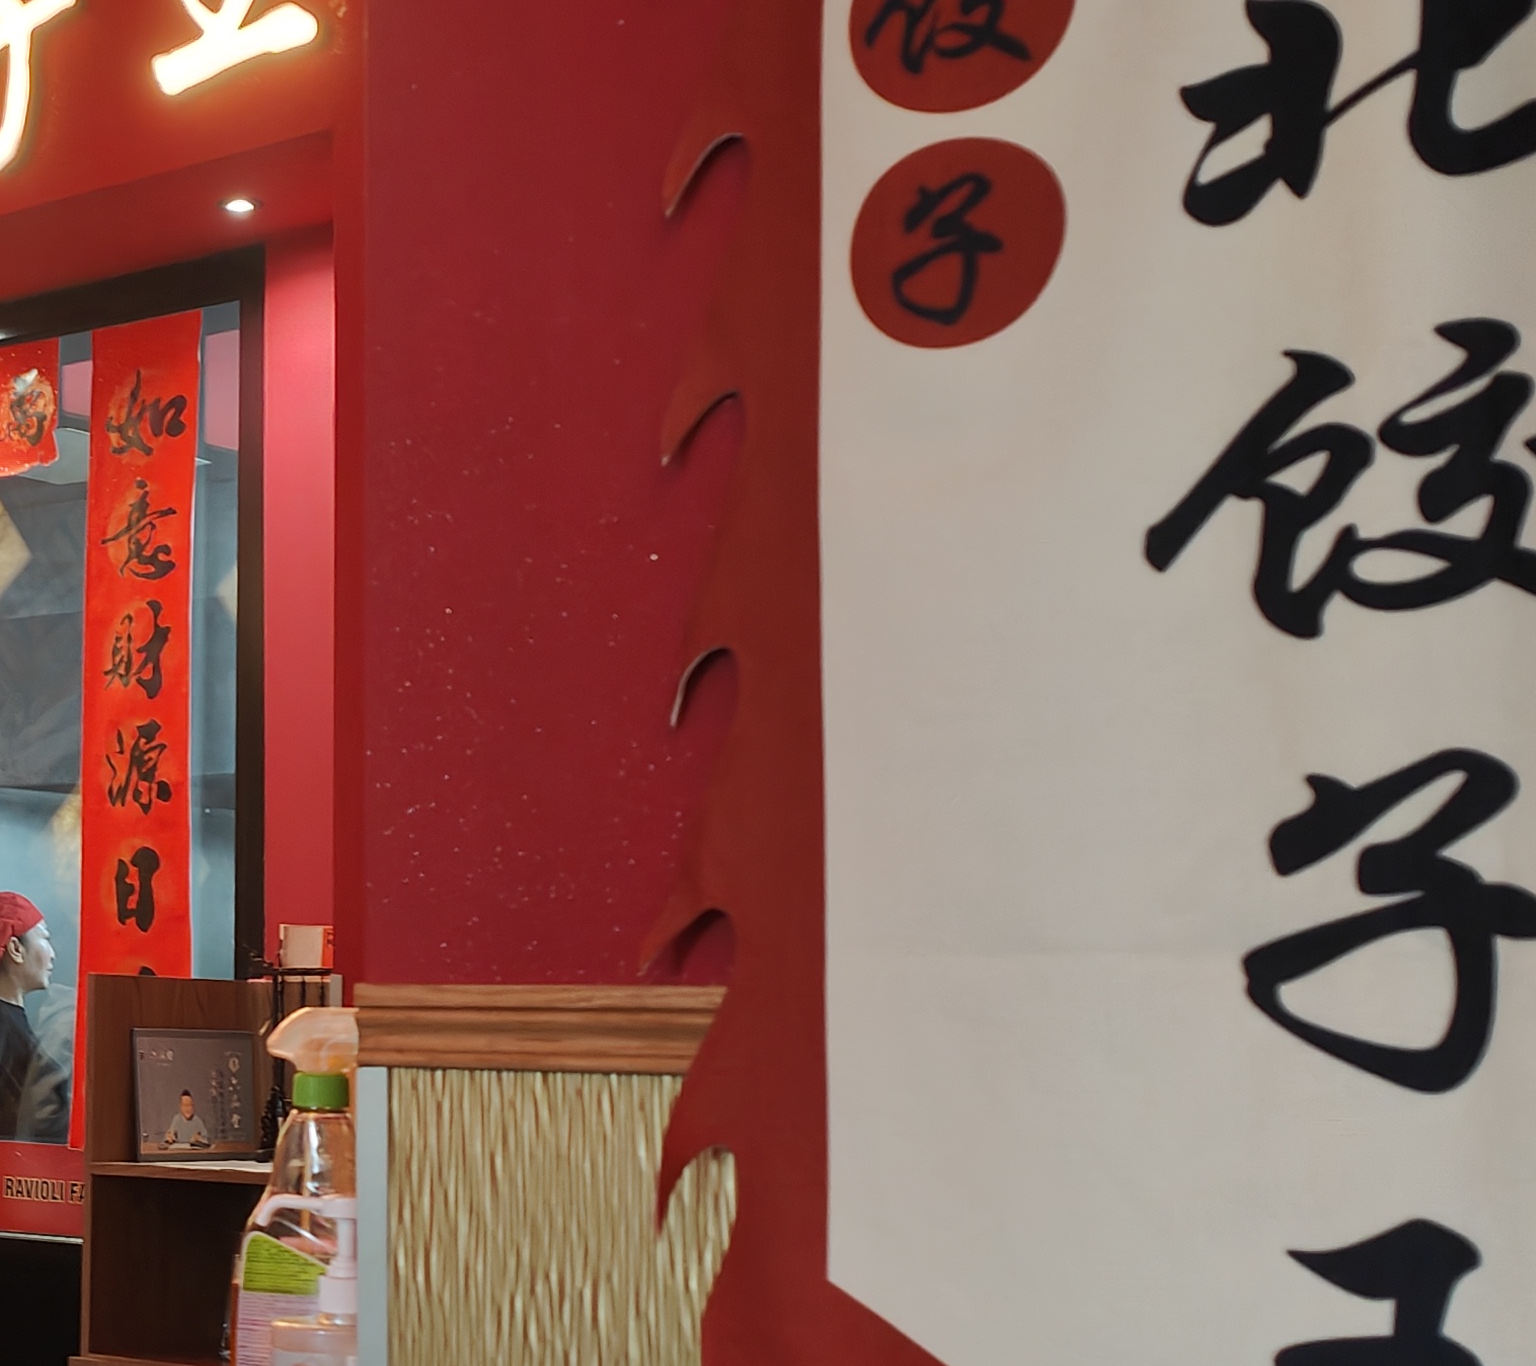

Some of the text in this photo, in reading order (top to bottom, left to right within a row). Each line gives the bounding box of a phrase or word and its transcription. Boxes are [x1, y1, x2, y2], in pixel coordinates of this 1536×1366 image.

[101, 368, 187, 976] 如意財源日
[2, 1175, 65, 1203] RAVIOLI
